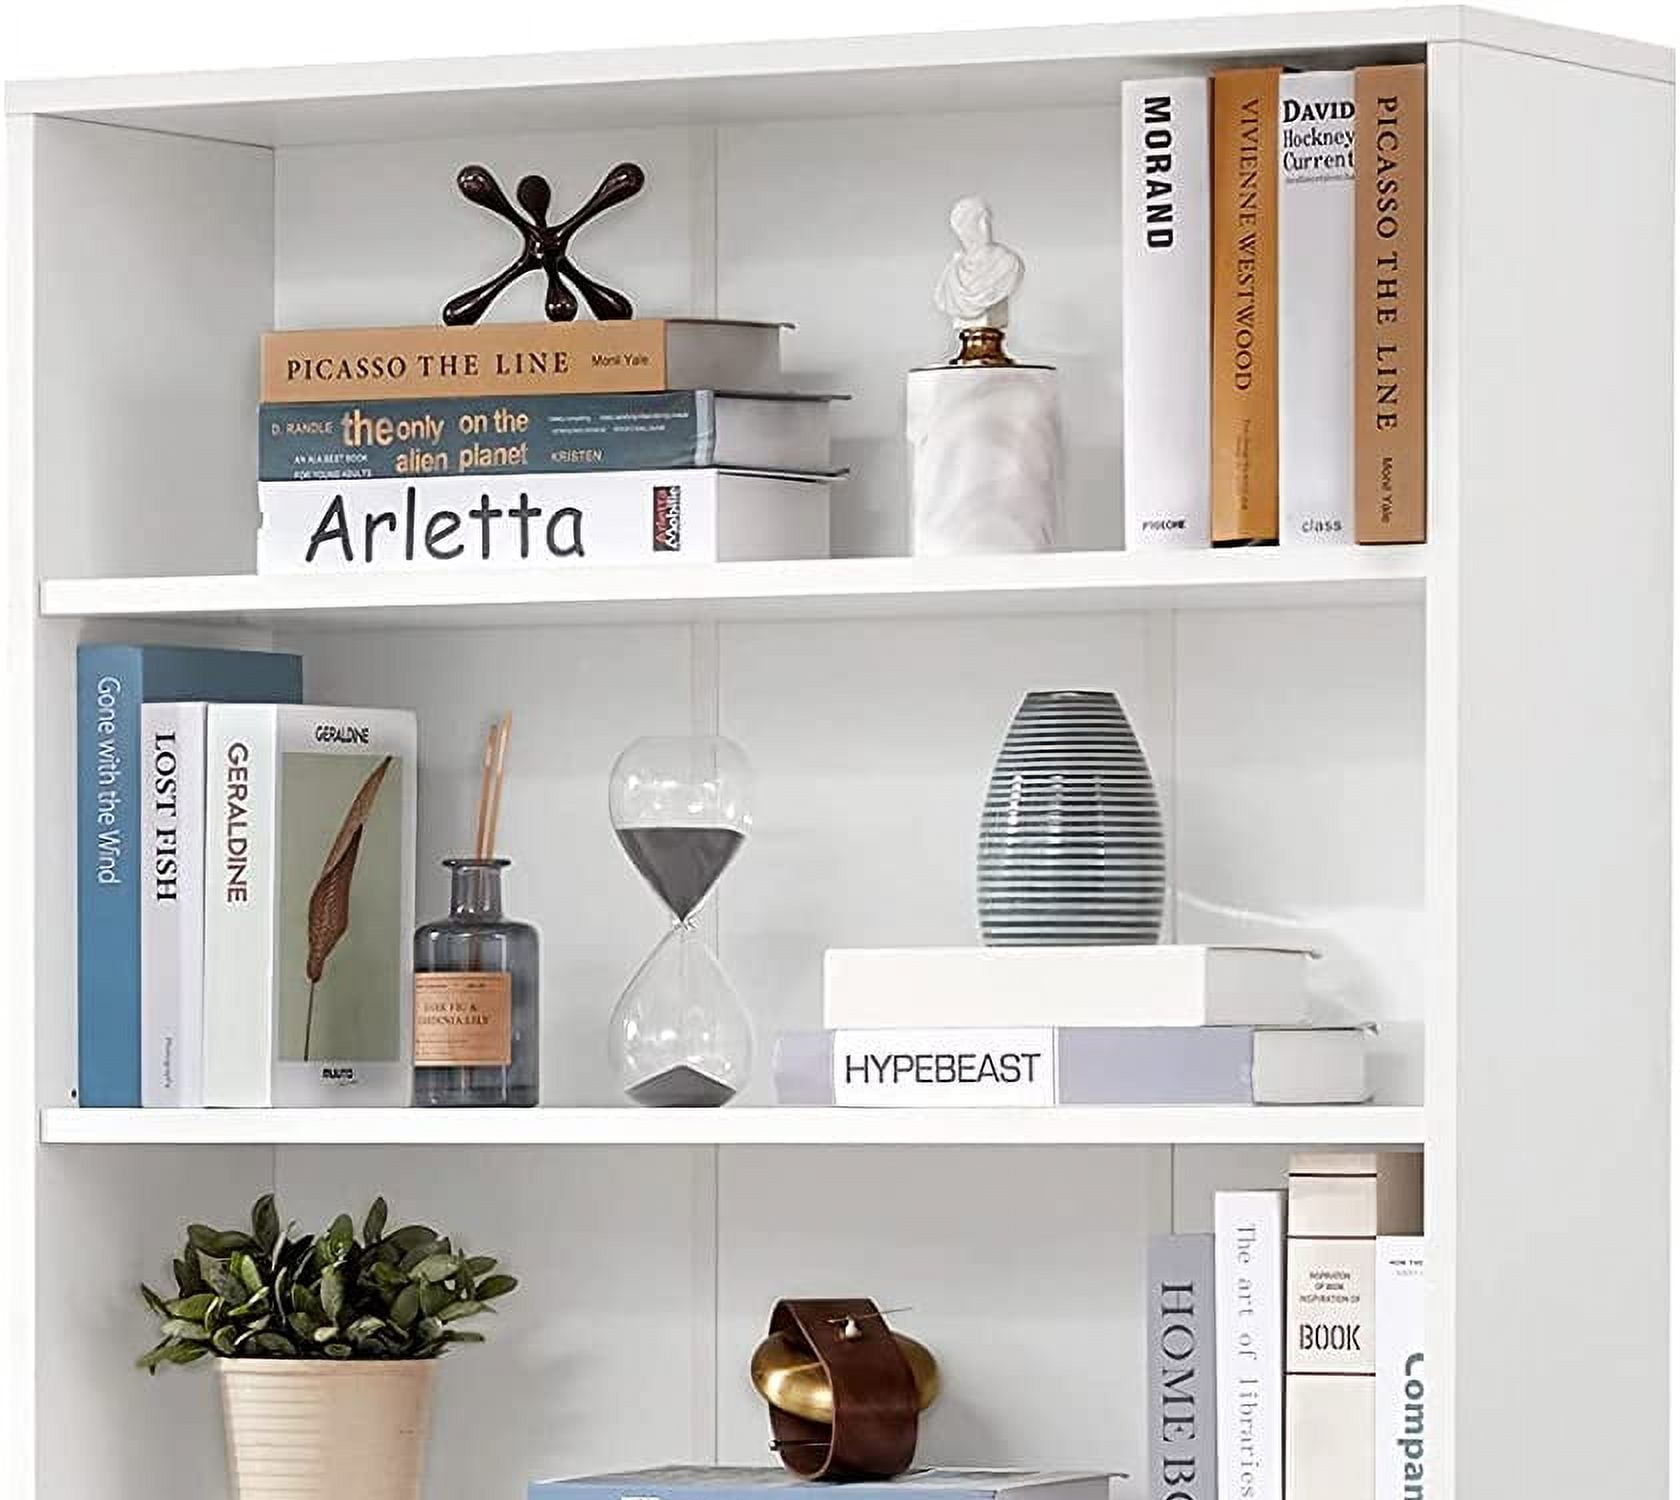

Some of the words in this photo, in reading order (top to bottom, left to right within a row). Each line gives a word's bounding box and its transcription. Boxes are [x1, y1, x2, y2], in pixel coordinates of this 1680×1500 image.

[1282, 99, 1355, 123] DAVID
[1283, 127, 1355, 149] Hockney
[1283, 151, 1354, 171] Current
[1144, 96, 1174, 249] MORAND
[1235, 99, 1259, 232] VIVIENNE
[1377, 96, 1398, 240] PICASSO
[1377, 252, 1399, 324] THE
[1233, 234, 1256, 391] WESTWOOD
[287, 356, 406, 381] PICASSO
[417, 354, 479, 378] THE
[496, 351, 569, 376] LINE
[1377, 345, 1399, 431] LINE
[341, 408, 394, 447] the
[396, 416, 443, 446] only
[460, 413, 489, 434] on
[494, 409, 529, 432] the
[395, 448, 447, 472] alien
[458, 443, 529, 473] planet
[305, 486, 586, 562] Arletta
[1301, 519, 1343, 532] class
[97, 677, 121, 735] Gone
[315, 726, 370, 744] GERALDINE
[98, 737, 120, 785] with
[155, 732, 177, 817] LOST
[98, 789, 120, 825] the
[226, 743, 249, 903] GERALDINE
[97, 828, 121, 885] Wind
[156, 828, 178, 901] FISH
[845, 1053, 1041, 1084] HYPEBEAST
[1236, 1224, 1256, 1265] The
[1237, 1279, 1254, 1318] art
[1238, 1333, 1258, 1362] of
[1299, 1324, 1361, 1350] BOOK
[1161, 1282, 1195, 1443] HOME
[1238, 1378, 1261, 1499] libraries
